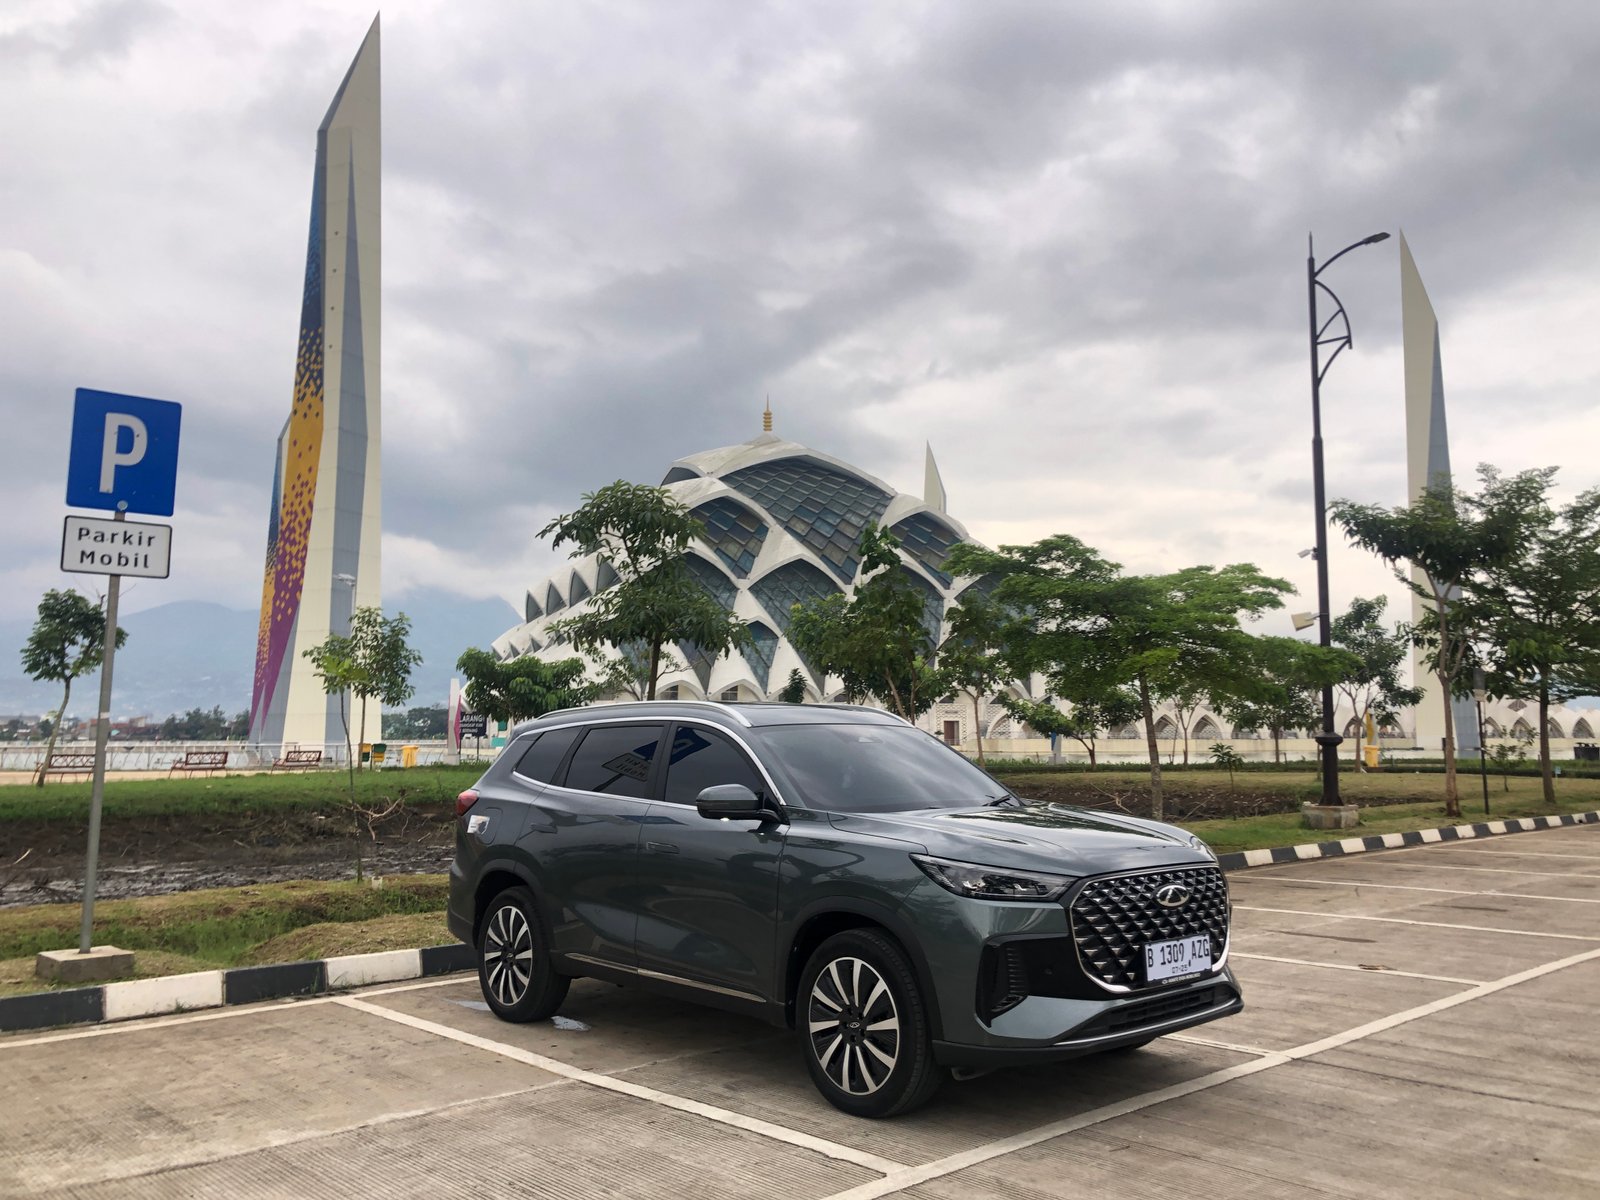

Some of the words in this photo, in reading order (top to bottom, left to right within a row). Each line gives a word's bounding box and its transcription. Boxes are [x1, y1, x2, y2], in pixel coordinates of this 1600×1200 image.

[99, 412, 148, 494] P
[77, 527, 156, 547] Parkir
[79, 550, 150, 569] Mobil
[1147, 948, 1154, 968] B
[1160, 943, 1185, 965] 1309
[1191, 939, 1210, 960] AZG
